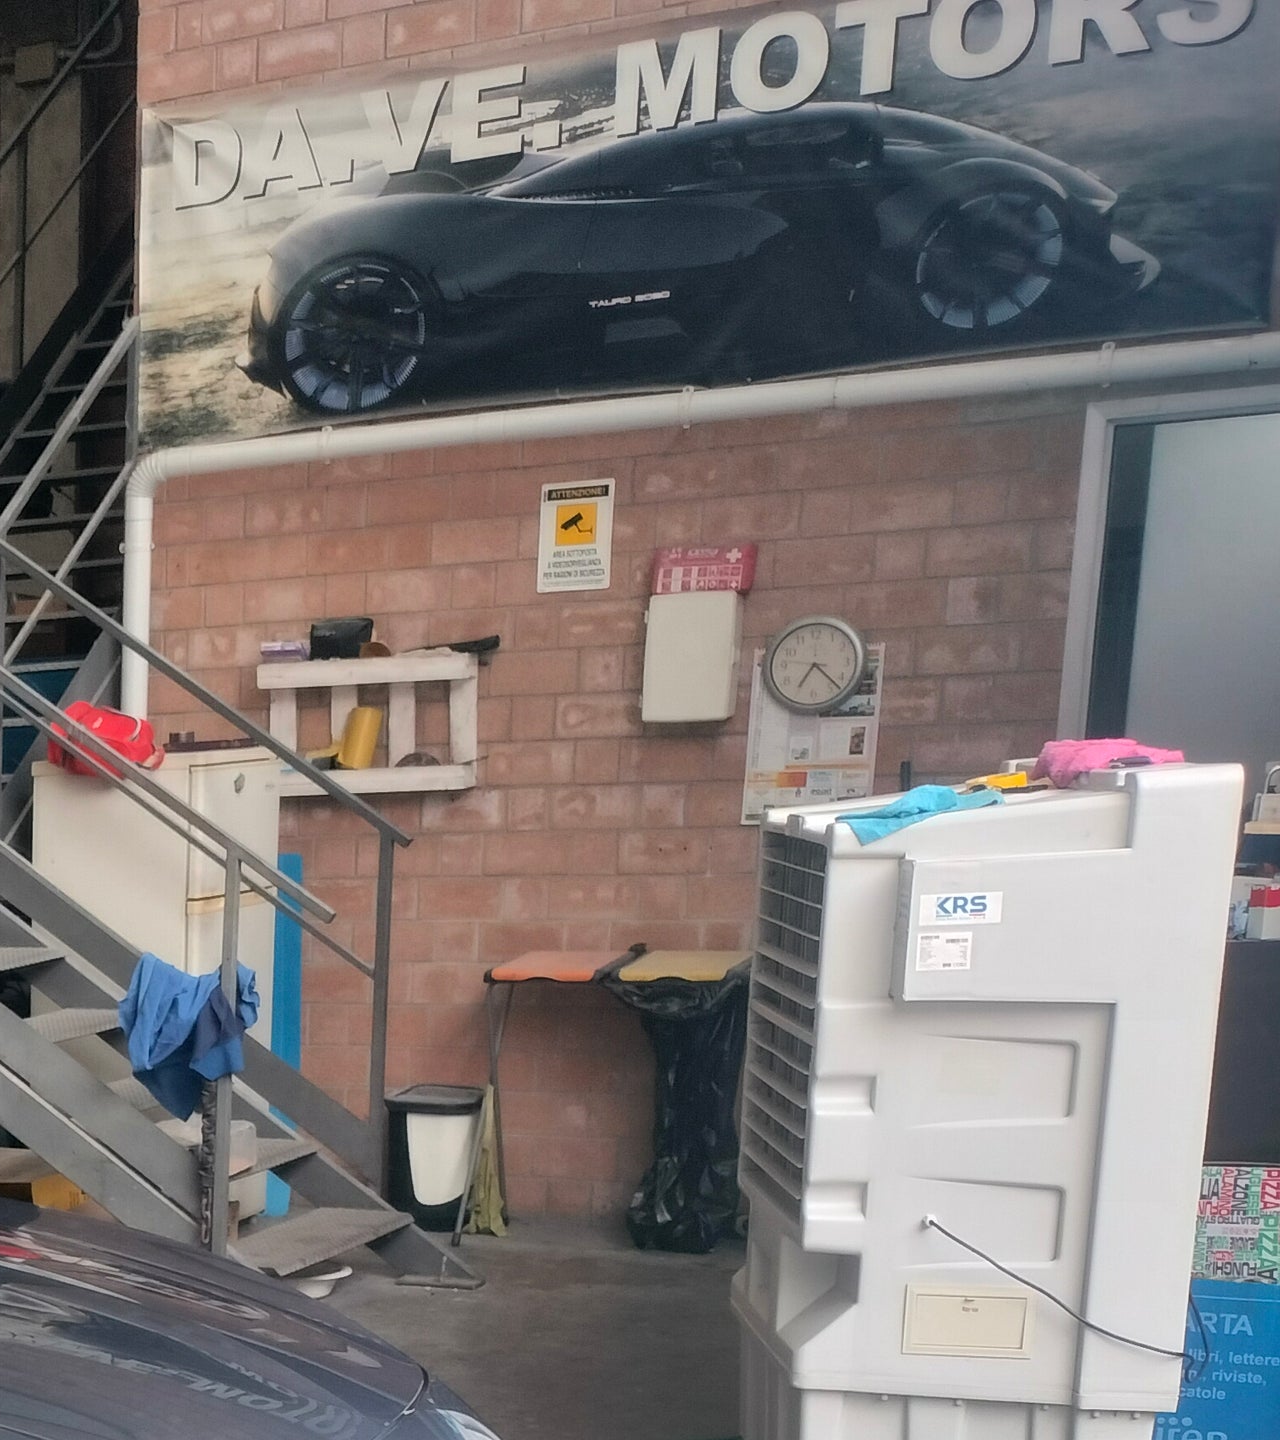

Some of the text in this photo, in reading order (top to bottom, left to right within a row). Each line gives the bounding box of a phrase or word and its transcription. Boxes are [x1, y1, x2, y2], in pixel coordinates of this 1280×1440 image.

[936, 895, 987, 915] KRS
[1257, 1215, 1279, 1271] PIZZA
[1212, 1261, 1258, 1277] FUNGHI
[1212, 1369, 1267, 1386] riviste,
